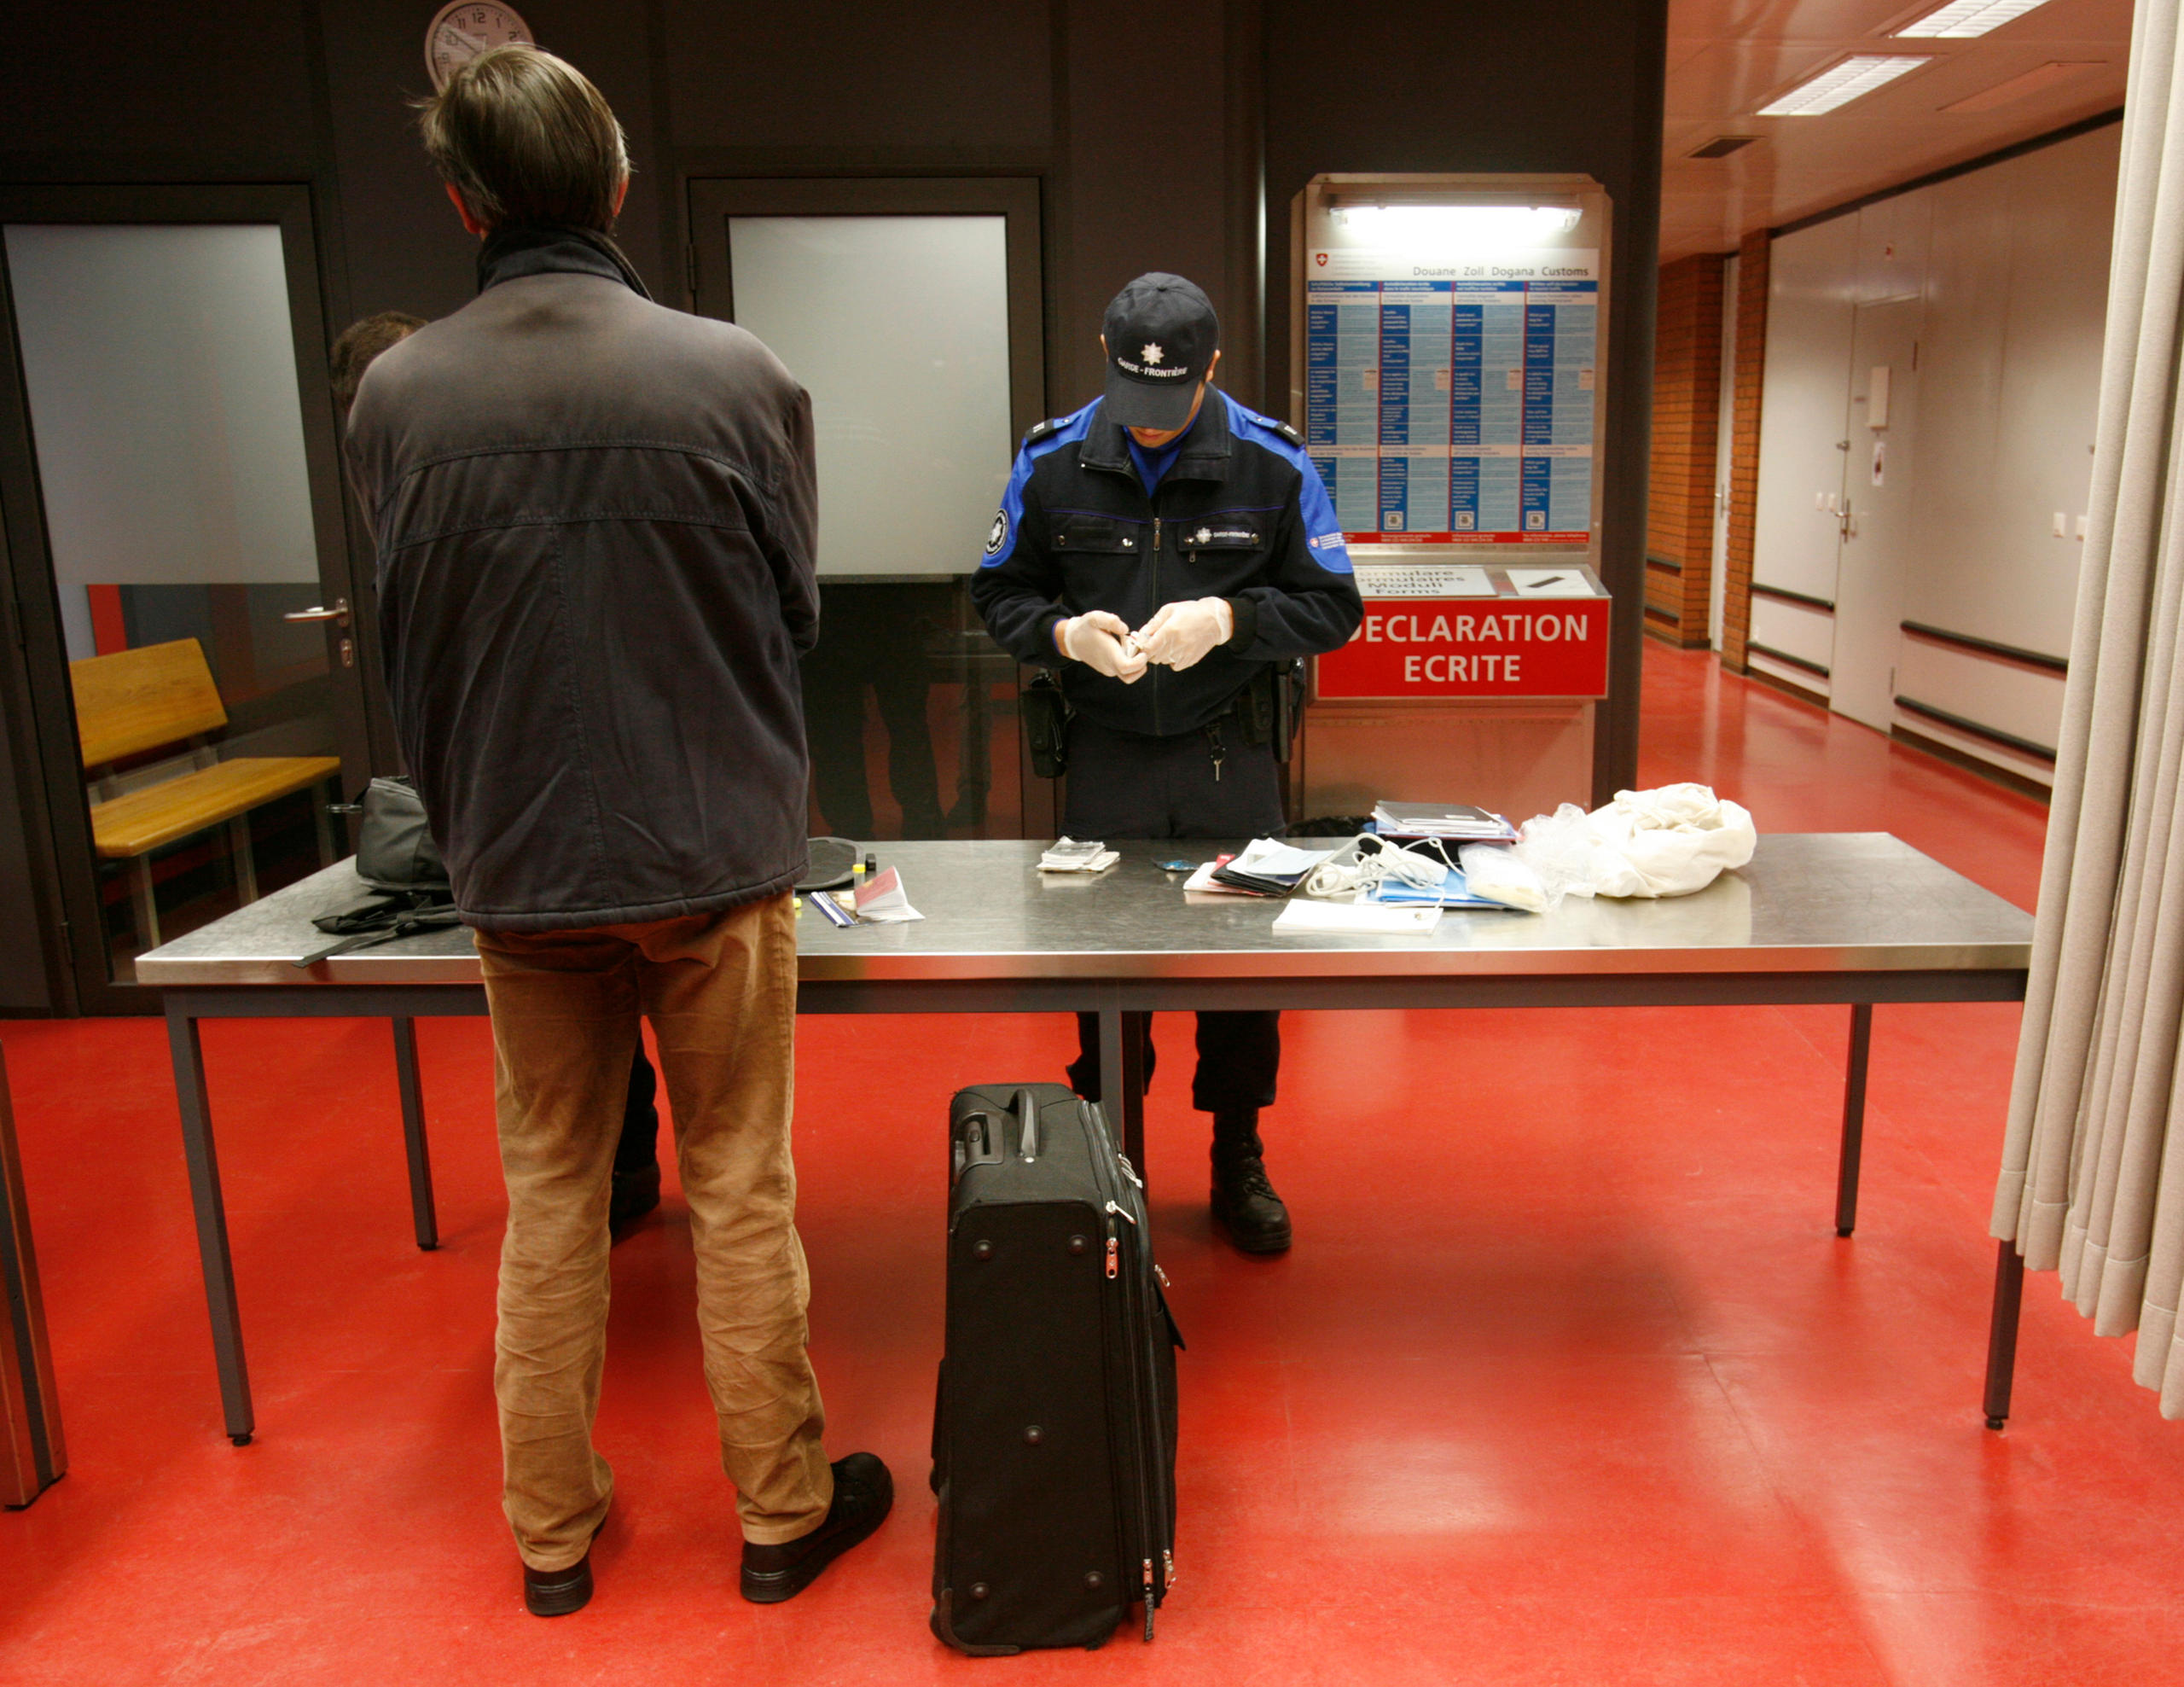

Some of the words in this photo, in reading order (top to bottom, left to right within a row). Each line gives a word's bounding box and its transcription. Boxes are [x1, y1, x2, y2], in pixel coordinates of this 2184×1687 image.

[457, 18, 467, 29] 11
[473, 12, 485, 24] 12
[496, 17, 501, 28] 1
[1413, 266, 1456, 276] Douane
[1464, 266, 1484, 276] Zoll
[1491, 266, 1535, 279] Dogana
[1542, 266, 1589, 276] Customs
[1404, 654, 1521, 683] ECRITE
